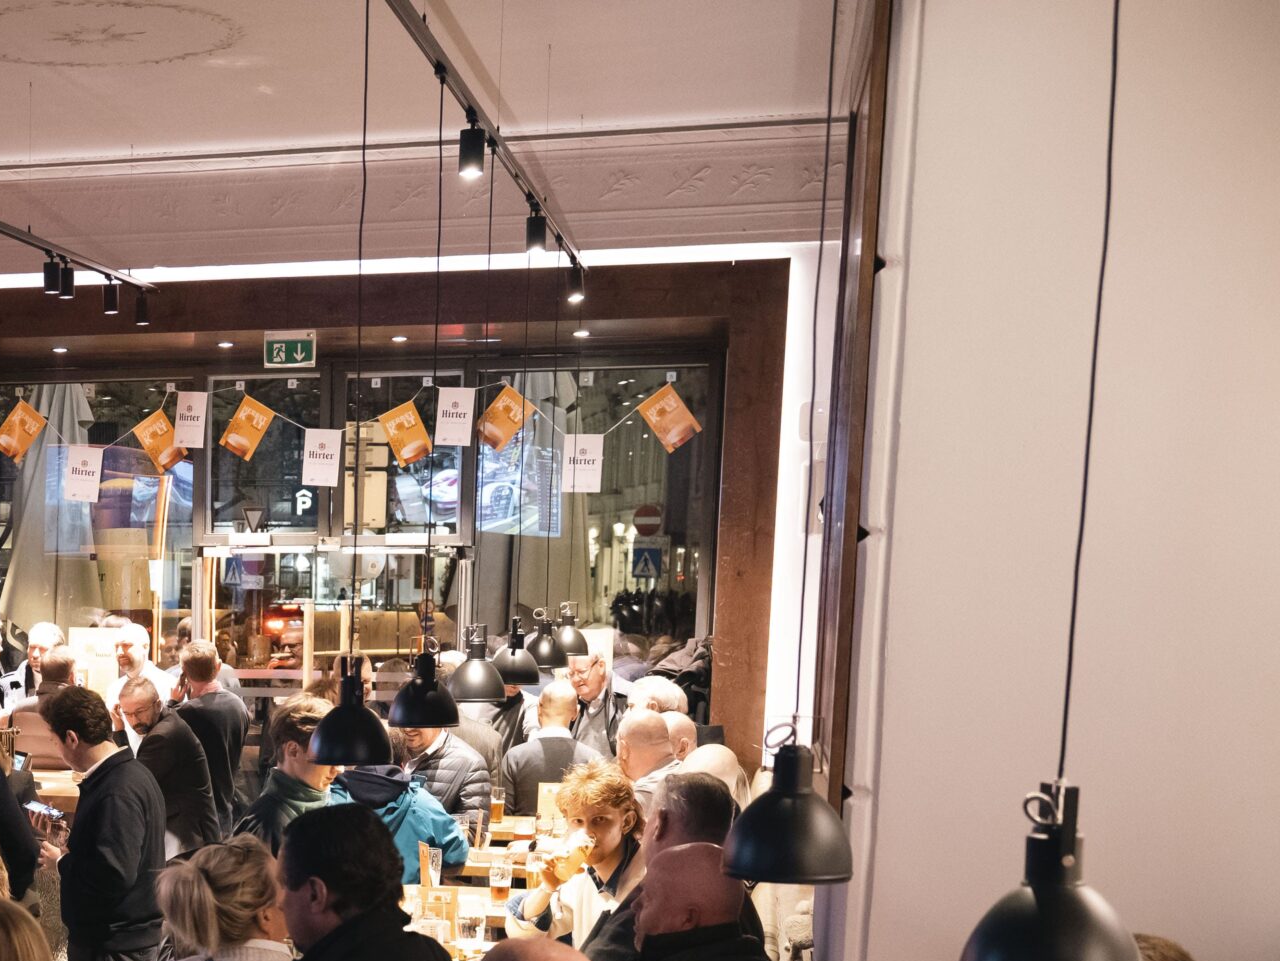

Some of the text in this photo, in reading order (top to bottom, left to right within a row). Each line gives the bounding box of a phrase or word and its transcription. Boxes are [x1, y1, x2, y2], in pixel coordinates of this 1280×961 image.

[179, 413, 201, 422] Hirter
[441, 409, 467, 419] Hirter
[308, 450, 335, 460] Hirter
[568, 456, 597, 466] Hirter
[71, 466, 96, 477] Hirter
[296, 496, 313, 516] P
